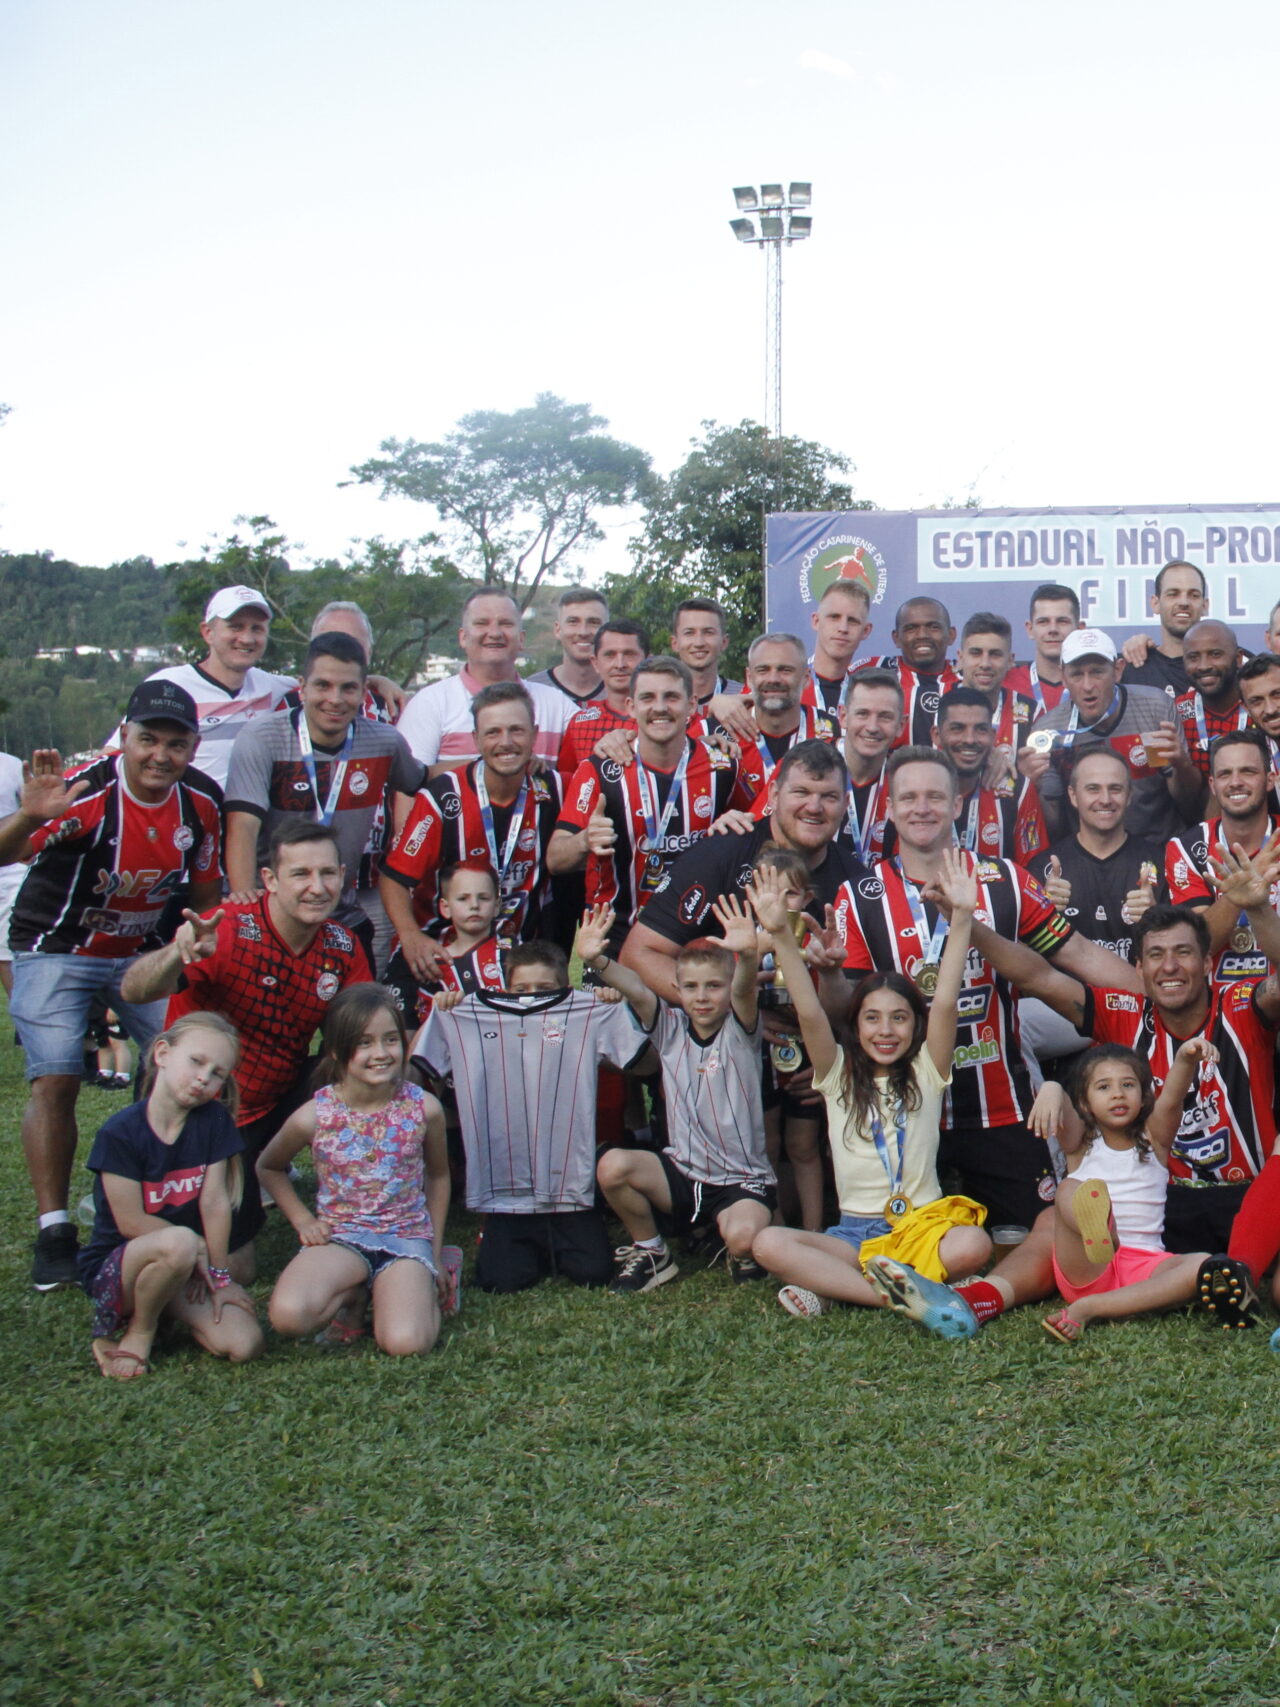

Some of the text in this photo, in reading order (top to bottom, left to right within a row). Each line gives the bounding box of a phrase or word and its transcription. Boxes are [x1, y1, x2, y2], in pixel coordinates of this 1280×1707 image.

[932, 528, 1105, 569] ESTADUAL
[799, 534, 888, 605] FEDERAÇÃO CATARINENSE DE FUTEBOL
[444, 798, 461, 812] 49
[1223, 957, 1267, 970] CHICO
